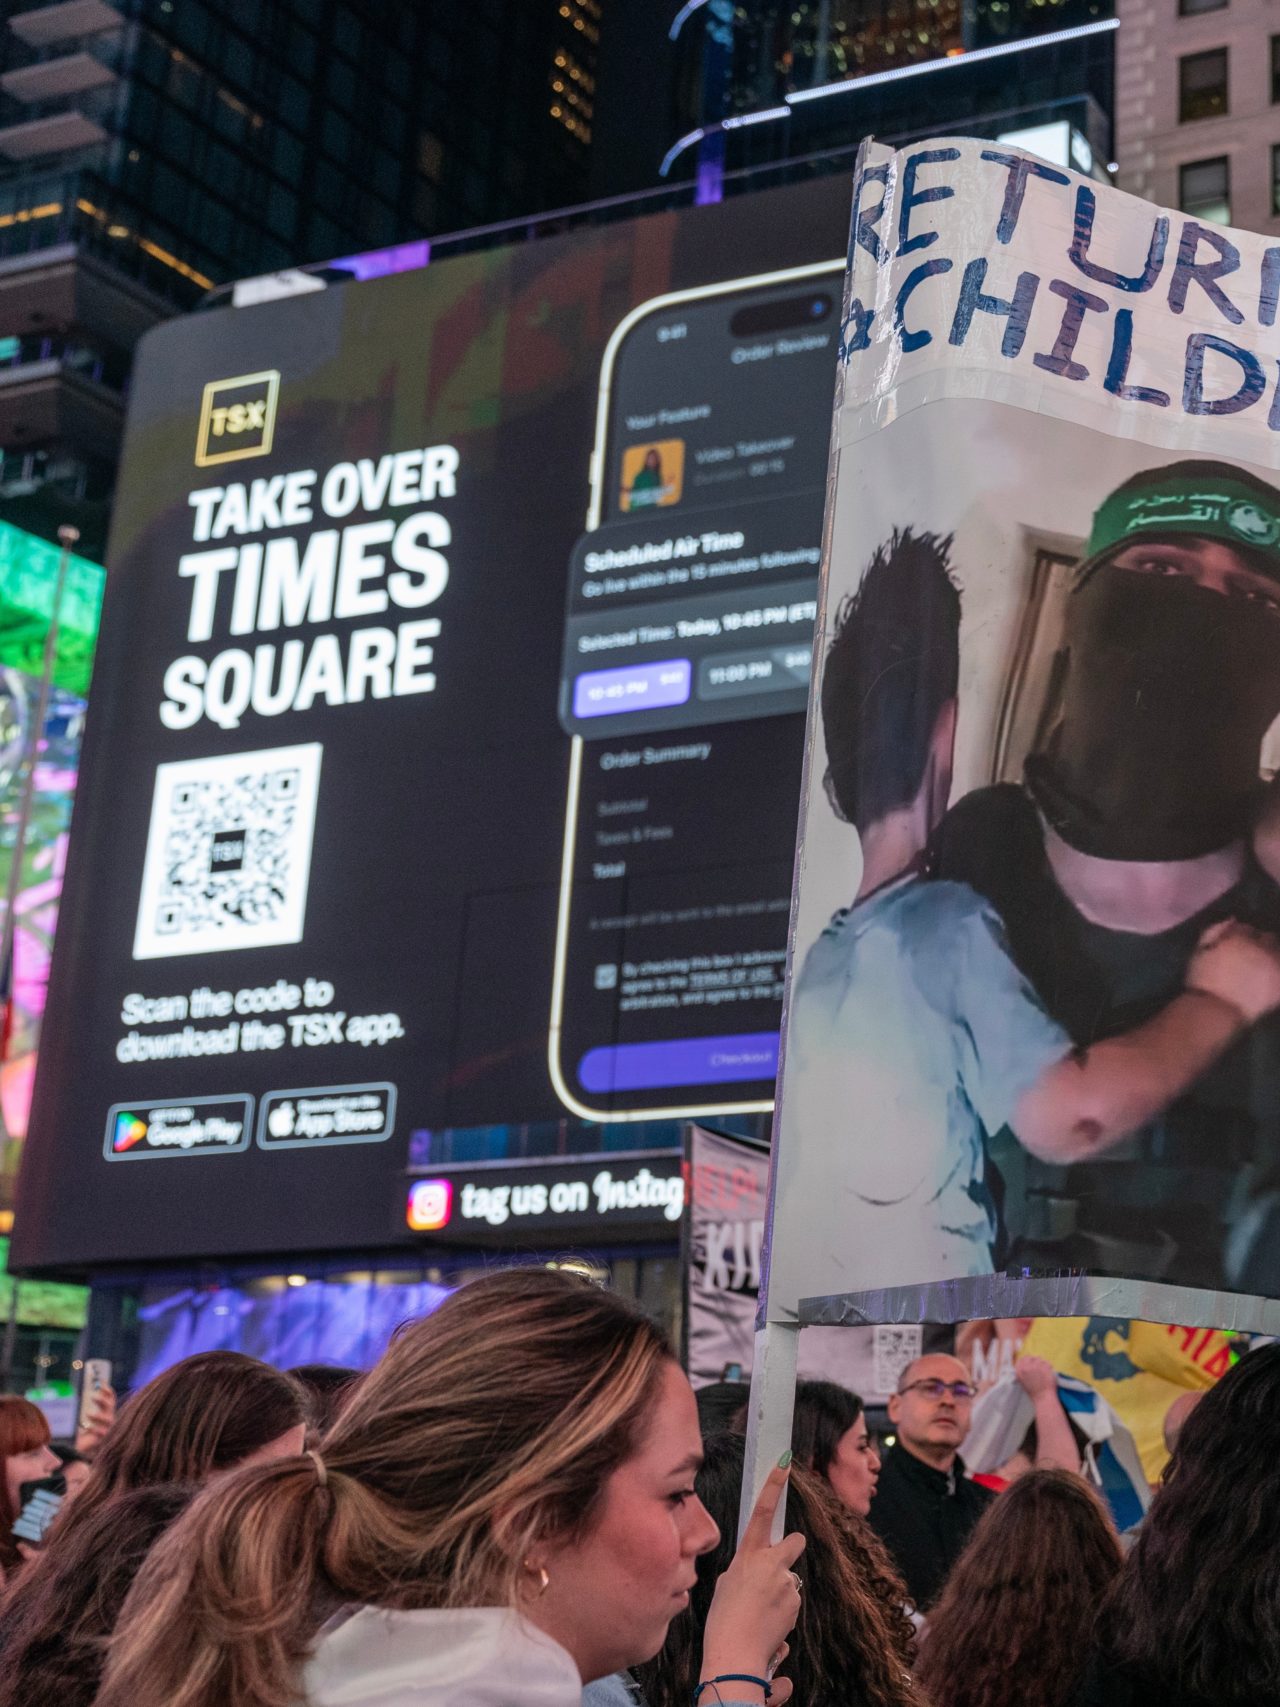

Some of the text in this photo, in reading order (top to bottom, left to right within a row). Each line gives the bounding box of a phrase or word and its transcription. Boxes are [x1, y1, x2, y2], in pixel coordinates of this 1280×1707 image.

[731, 333, 829, 365] Order Review
[210, 399, 267, 437] TSX
[625, 403, 712, 432] Your Feature
[188, 444, 460, 541] TAKE OVER
[584, 530, 745, 573] Scheduled Air Time
[178, 511, 452, 643] TIMES
[577, 629, 637, 653] Selected
[159, 617, 442, 730] SQUARE
[600, 742, 712, 772] Order Summary
[121, 977, 335, 1026] Scan the code to
[116, 1011, 406, 1064] download the TSX app.
[146, 1116, 244, 1150] Google Play
[294, 1109, 385, 1138] App Store
[460, 1168, 685, 1226] tag us on Instag
